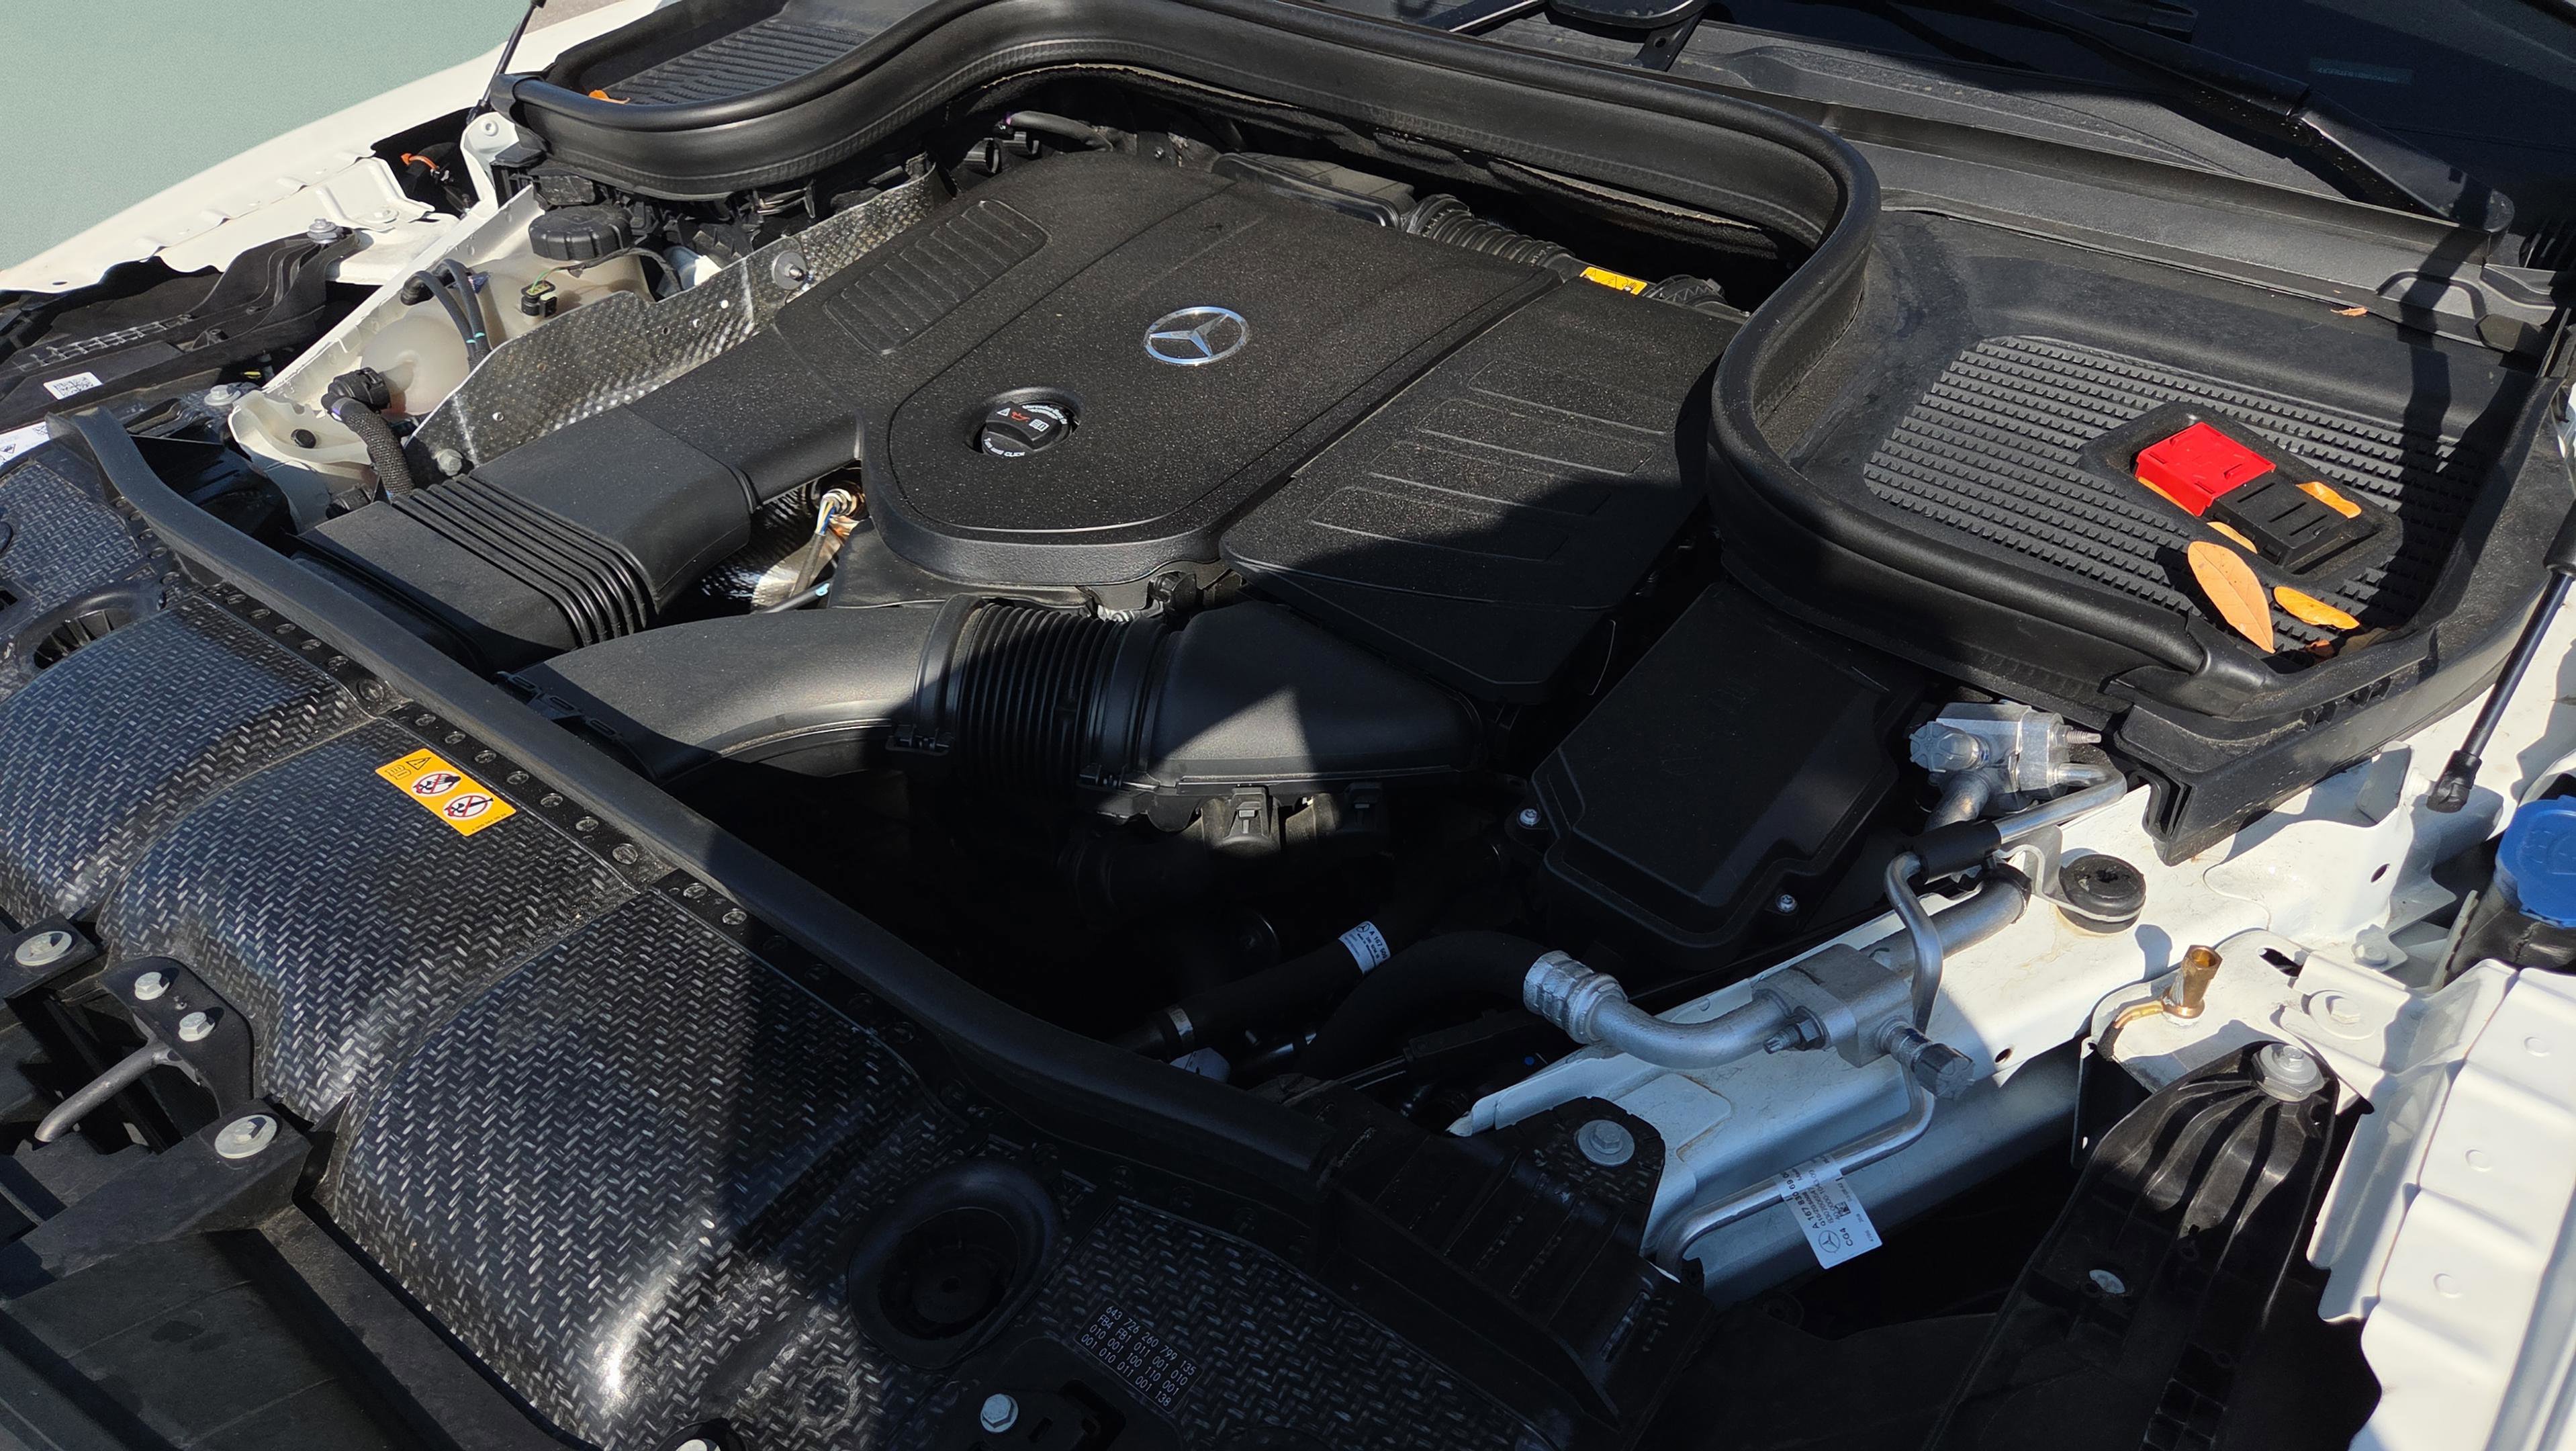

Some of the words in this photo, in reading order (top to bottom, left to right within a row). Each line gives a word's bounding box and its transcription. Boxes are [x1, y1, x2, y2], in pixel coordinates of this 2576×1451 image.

[1786, 1180, 1796, 1190] 69
[1792, 1192, 1805, 1205] 830
[1802, 1207, 1814, 1221] 167
[1840, 1228, 1853, 1247] CG4
[1089, 1324, 1107, 1339] 010
[1107, 1338, 1124, 1353] 001
[1126, 1352, 1143, 1368] 100
[1144, 1366, 1161, 1381] 110
[1162, 1380, 1179, 1396] 001
[1097, 1314, 1114, 1329] FB4
[1115, 1327, 1132, 1343] FB1
[1134, 1342, 1151, 1357] 011
[1152, 1356, 1168, 1372] 001
[1170, 1369, 1188, 1385] 010
[1105, 1306, 1123, 1321] 643
[1123, 1318, 1141, 1334] 726
[1142, 1331, 1159, 1348] 260
[1160, 1345, 1178, 1361] 799
[1180, 1360, 1197, 1376] 135
[1081, 1333, 1098, 1349] 001
[1099, 1348, 1116, 1364] 010
[1117, 1362, 1134, 1377] 011
[1135, 1376, 1152, 1392] 001
[1154, 1391, 1171, 1407] 138
